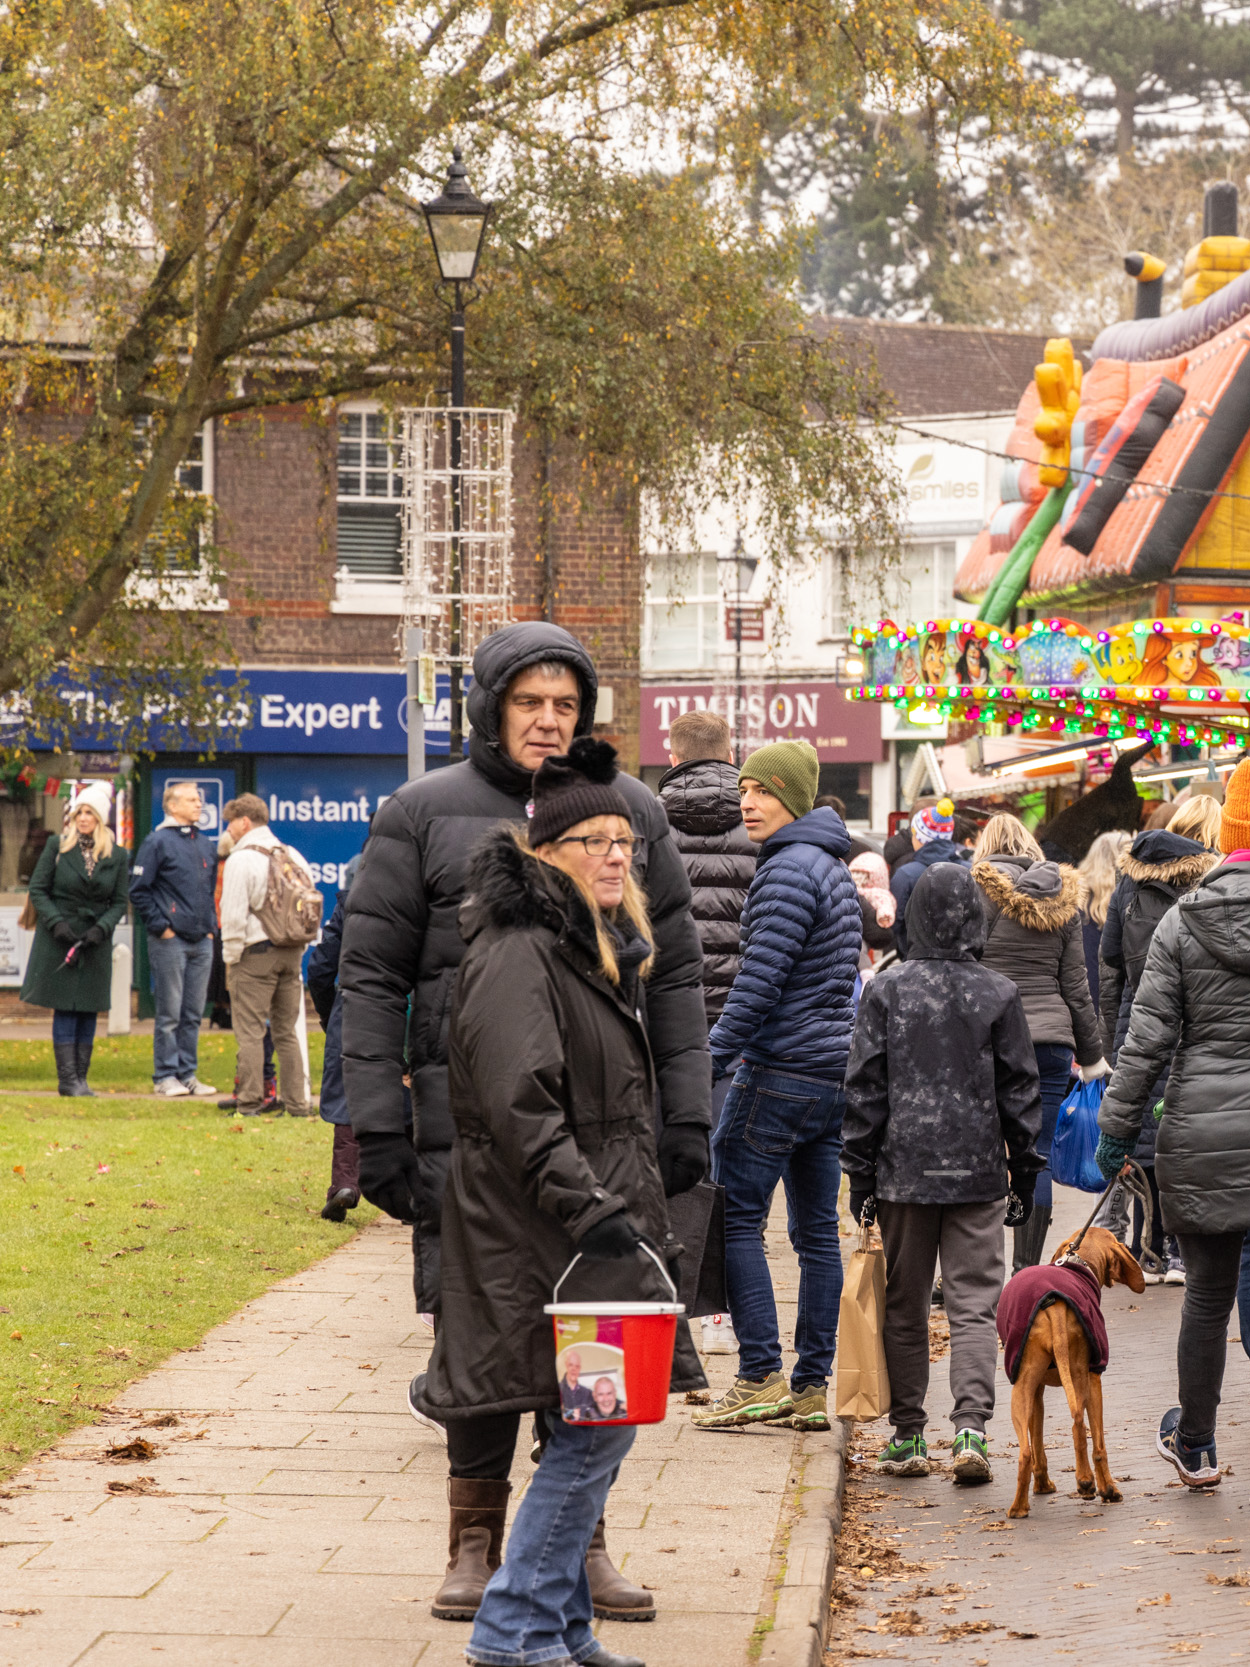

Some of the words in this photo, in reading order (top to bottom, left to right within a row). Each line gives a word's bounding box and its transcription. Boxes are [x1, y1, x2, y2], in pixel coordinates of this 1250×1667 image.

[910, 480, 980, 501] smiles
[261, 694, 383, 736] Expert
[270, 794, 370, 822] Instant
[1110, 1184, 1124, 1222] MOUR
